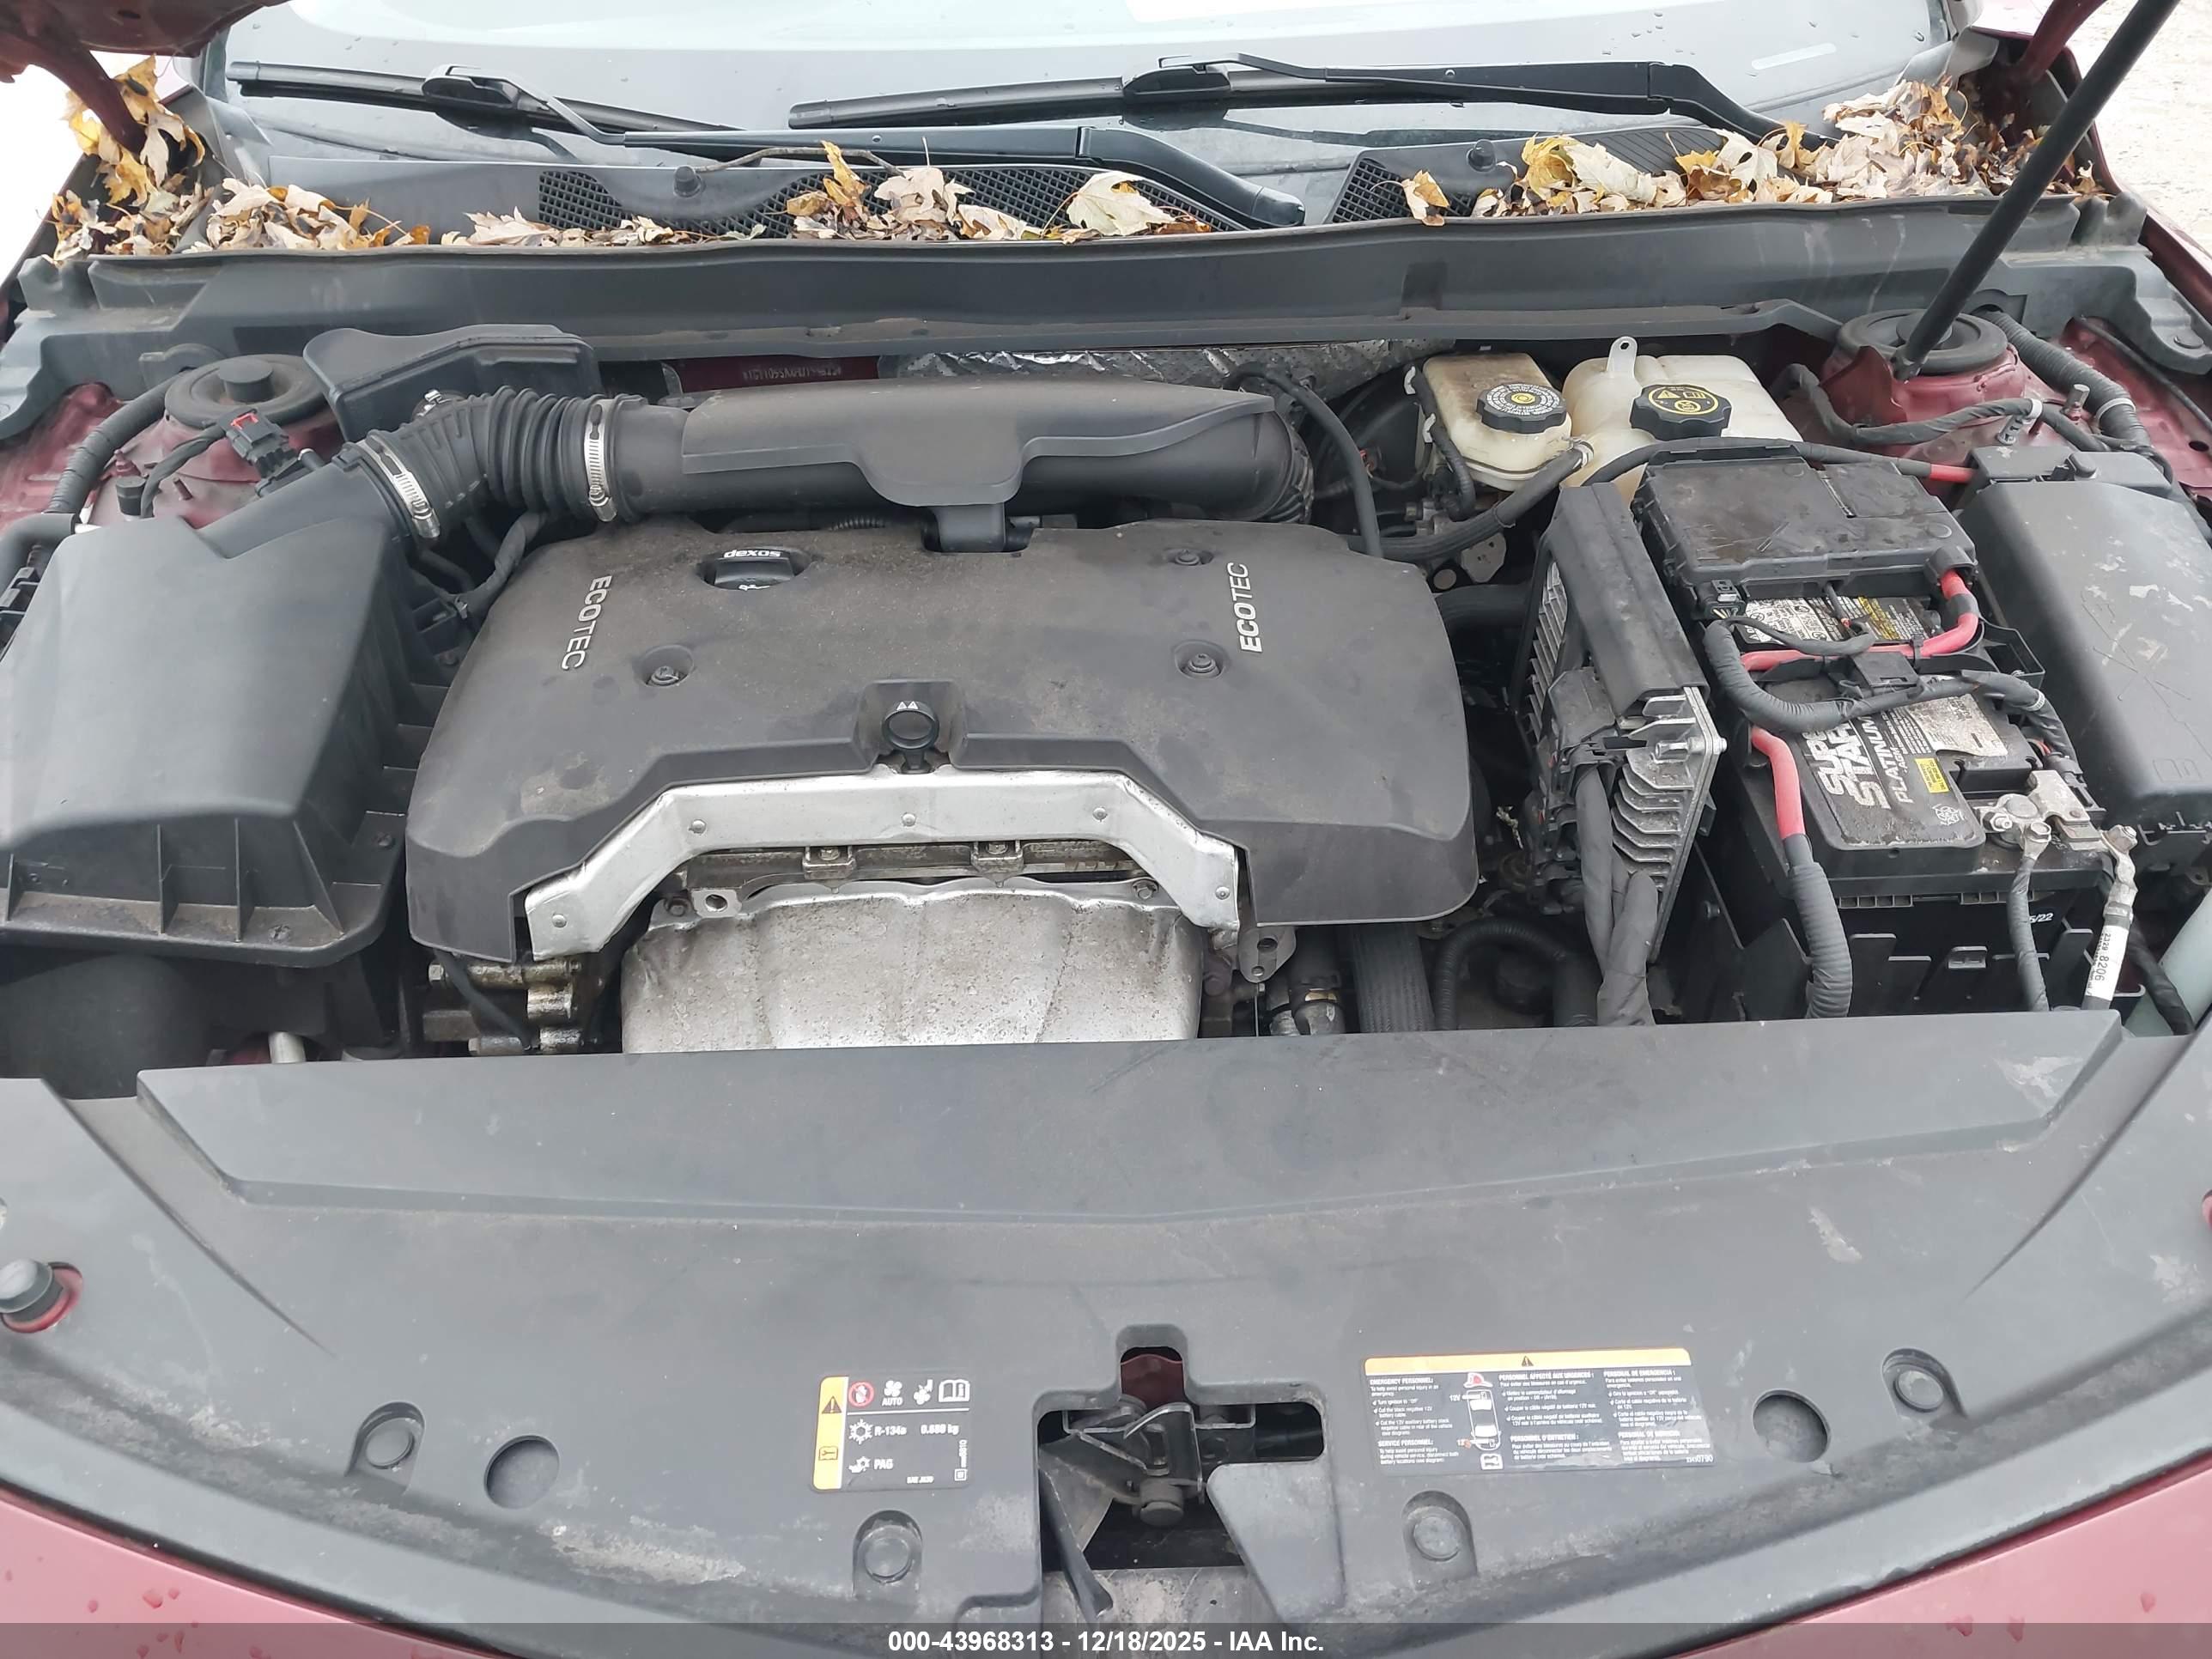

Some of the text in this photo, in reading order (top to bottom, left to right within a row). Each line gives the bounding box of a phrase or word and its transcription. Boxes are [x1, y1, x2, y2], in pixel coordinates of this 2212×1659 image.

[724, 550, 781, 558] dexos
[1227, 562, 1262, 653] ECOTEC
[562, 575, 612, 670] ECOTEC
[1802, 730, 1844, 795] SUPE
[1826, 723, 1892, 810] STAR
[2095, 955, 2110, 981] 8206
[882, 1396, 903, 1407] AUTO
[874, 1425, 907, 1437] R-134a
[873, 1458, 894, 1470] PAG
